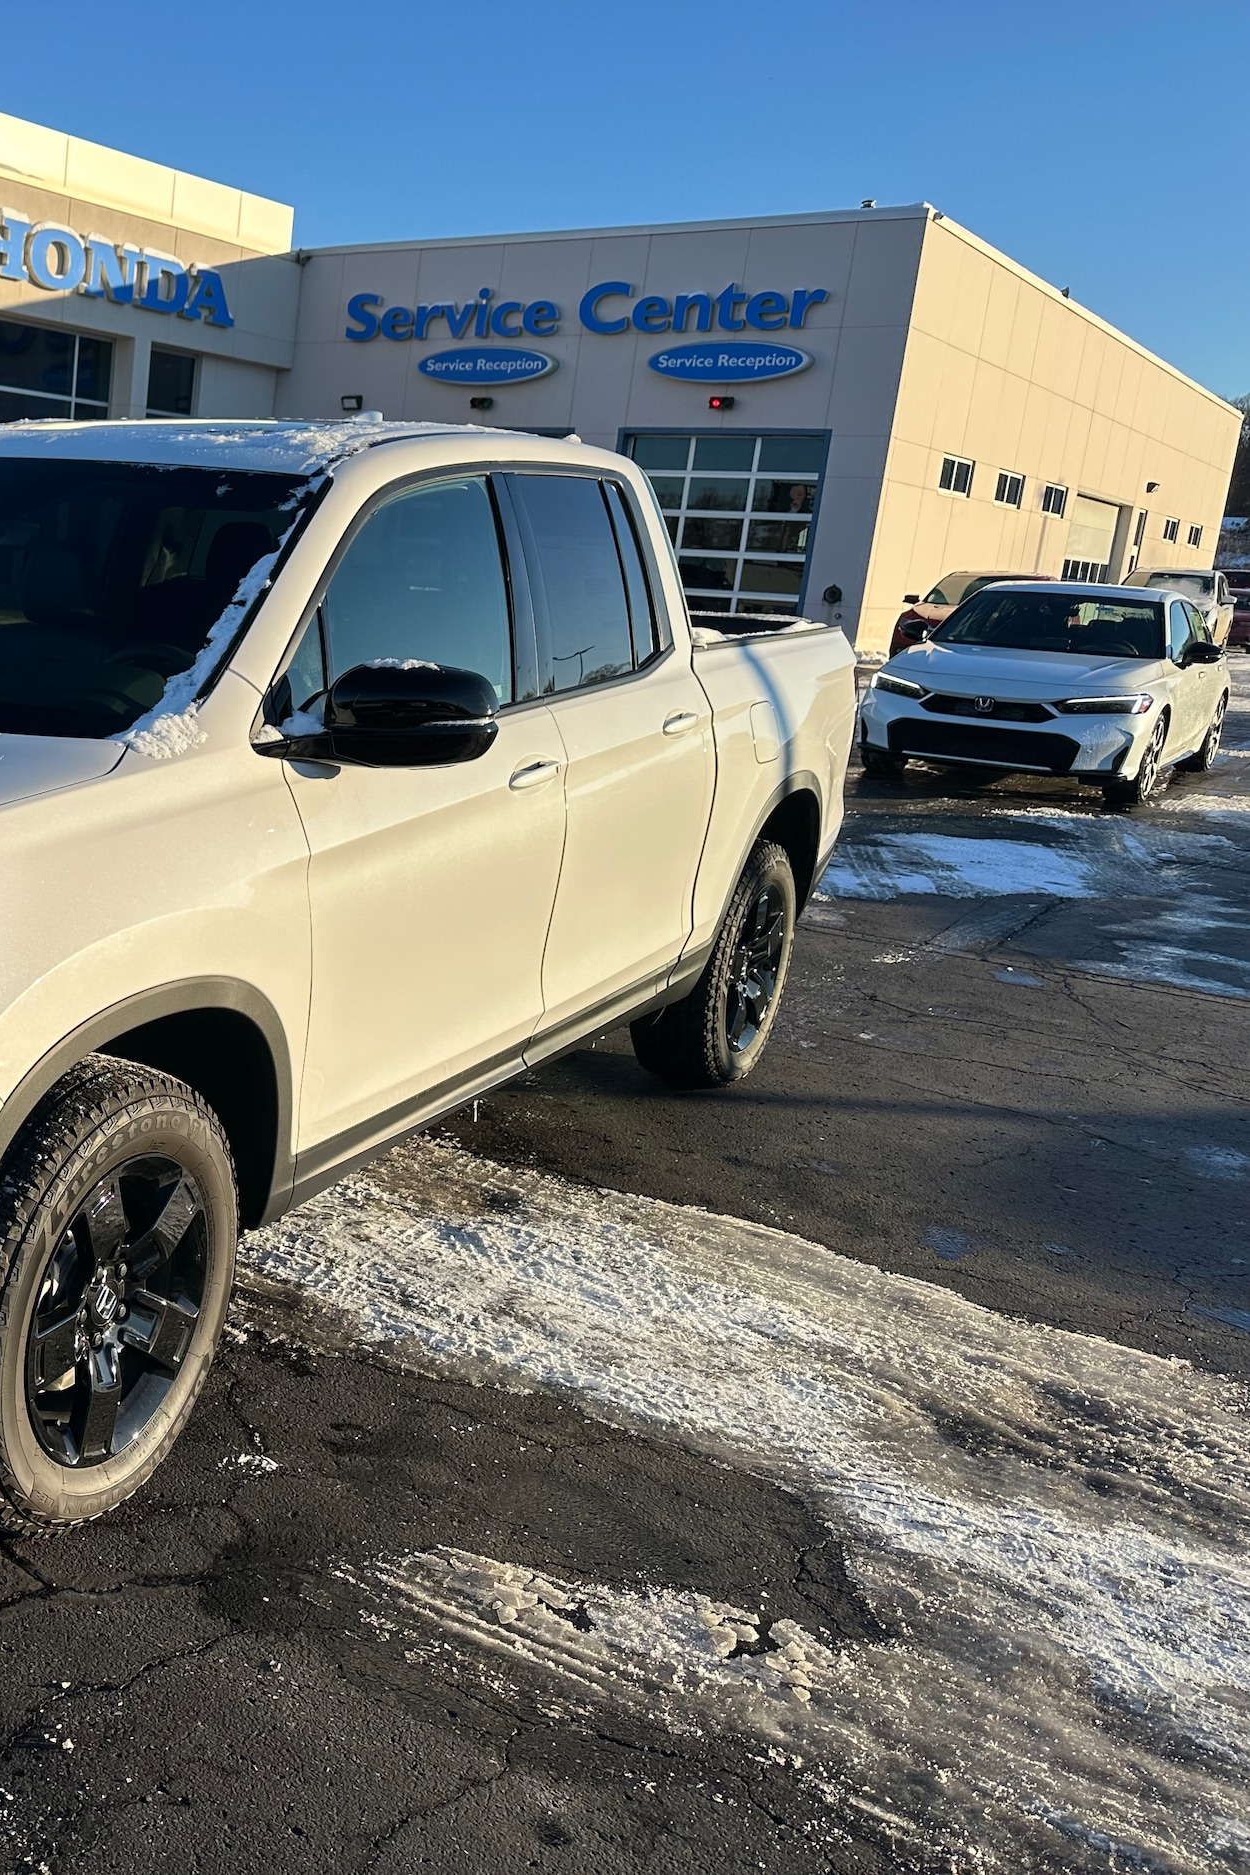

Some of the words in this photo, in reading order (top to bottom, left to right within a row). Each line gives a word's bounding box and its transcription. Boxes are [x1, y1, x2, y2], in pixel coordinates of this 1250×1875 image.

[345, 287, 561, 342] Service
[579, 281, 830, 334] Center
[426, 359, 473, 371] Service
[476, 357, 543, 373] Reception
[657, 354, 714, 368] Service
[717, 353, 796, 370] Reception
